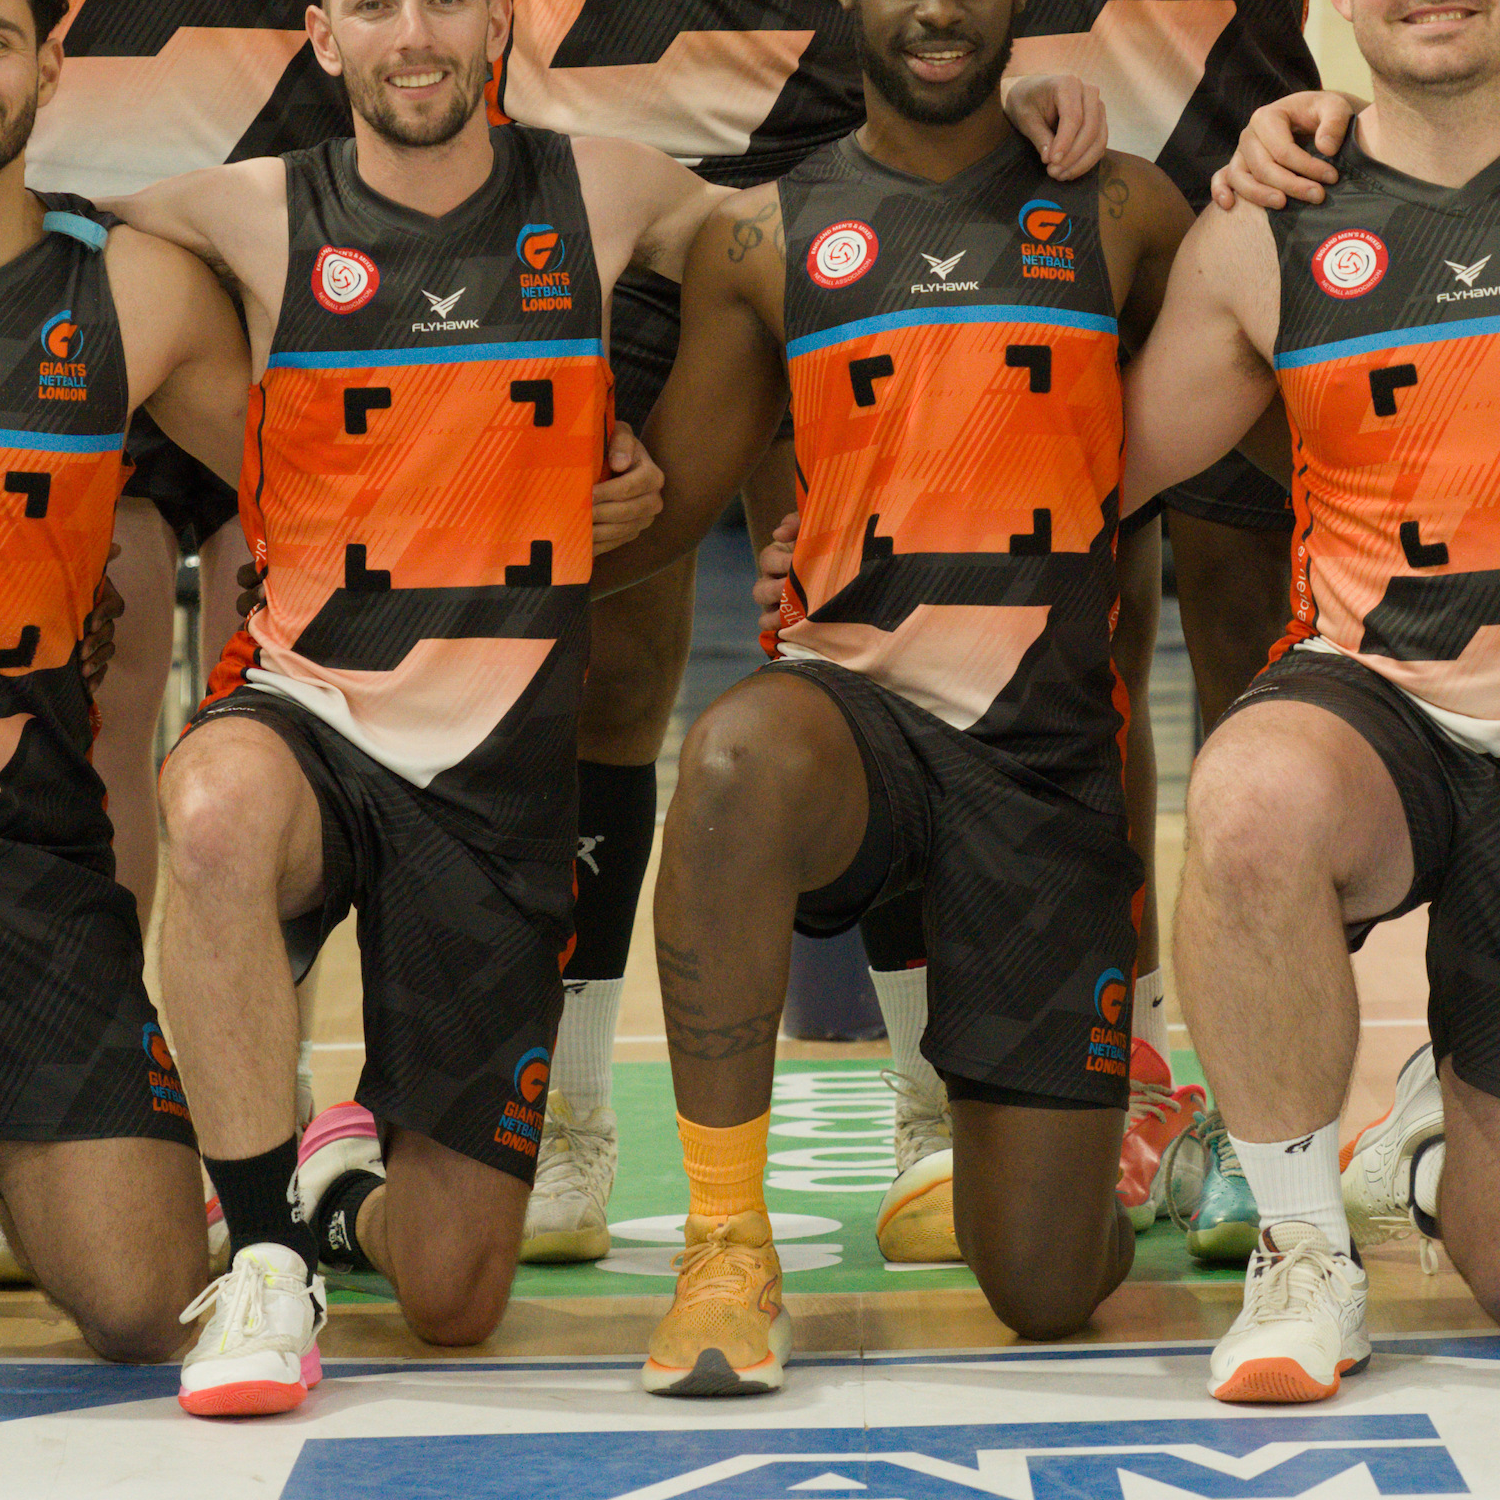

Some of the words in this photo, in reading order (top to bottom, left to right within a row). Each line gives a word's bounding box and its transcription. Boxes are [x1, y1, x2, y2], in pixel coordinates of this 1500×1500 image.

[1021, 243, 1074, 260] GIANTS
[1022, 255, 1075, 269] NETBALL
[520, 272, 570, 288] GIANTS
[1023, 266, 1074, 282] LONDON
[522, 285, 571, 298] NETBALL
[522, 296, 572, 312] LONDON
[38, 386, 86, 401] LONDON
